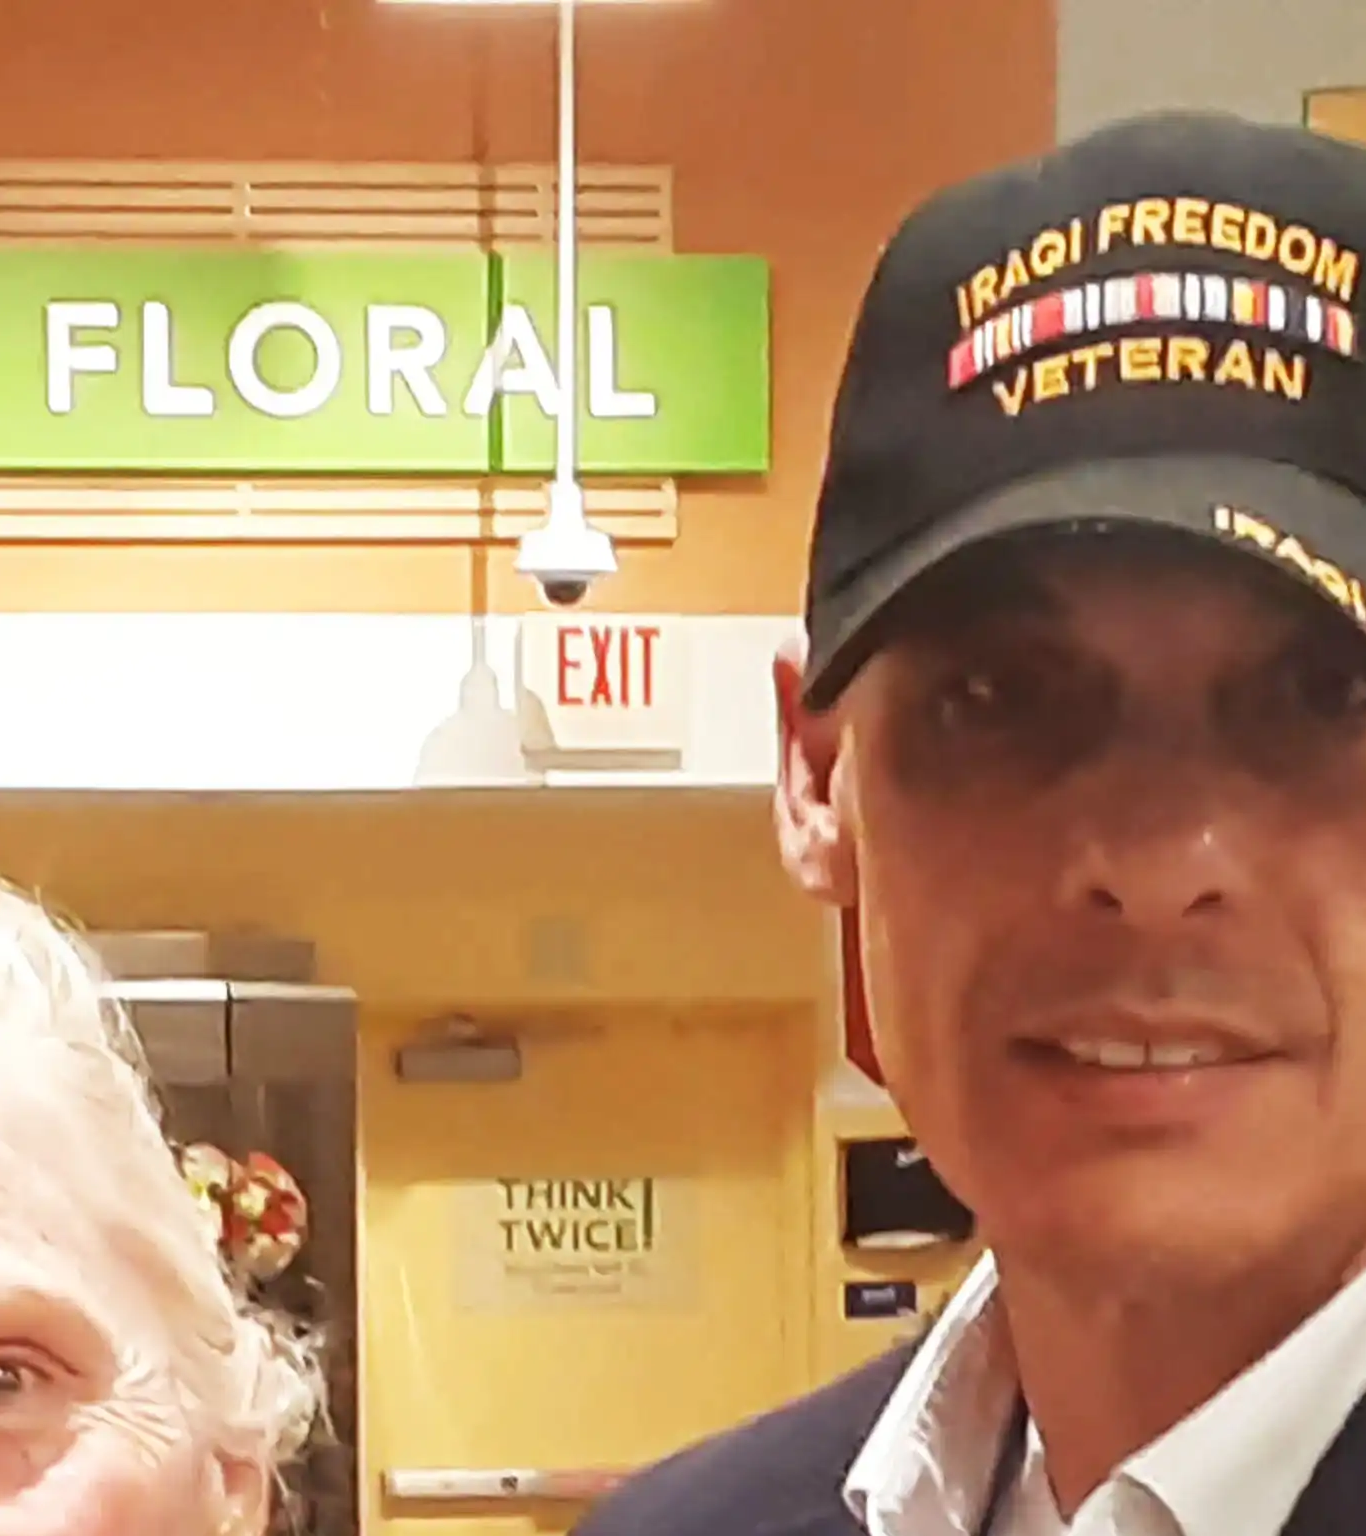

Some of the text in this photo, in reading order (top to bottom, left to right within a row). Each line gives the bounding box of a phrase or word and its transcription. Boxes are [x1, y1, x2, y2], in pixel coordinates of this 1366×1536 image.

[956, 197, 1358, 330] IRAQI FREEDOM
[44, 298, 658, 418] FLORAL
[992, 335, 1307, 417] VETERAN
[556, 626, 661, 708] EXIT
[496, 1177, 636, 1211] THINK
